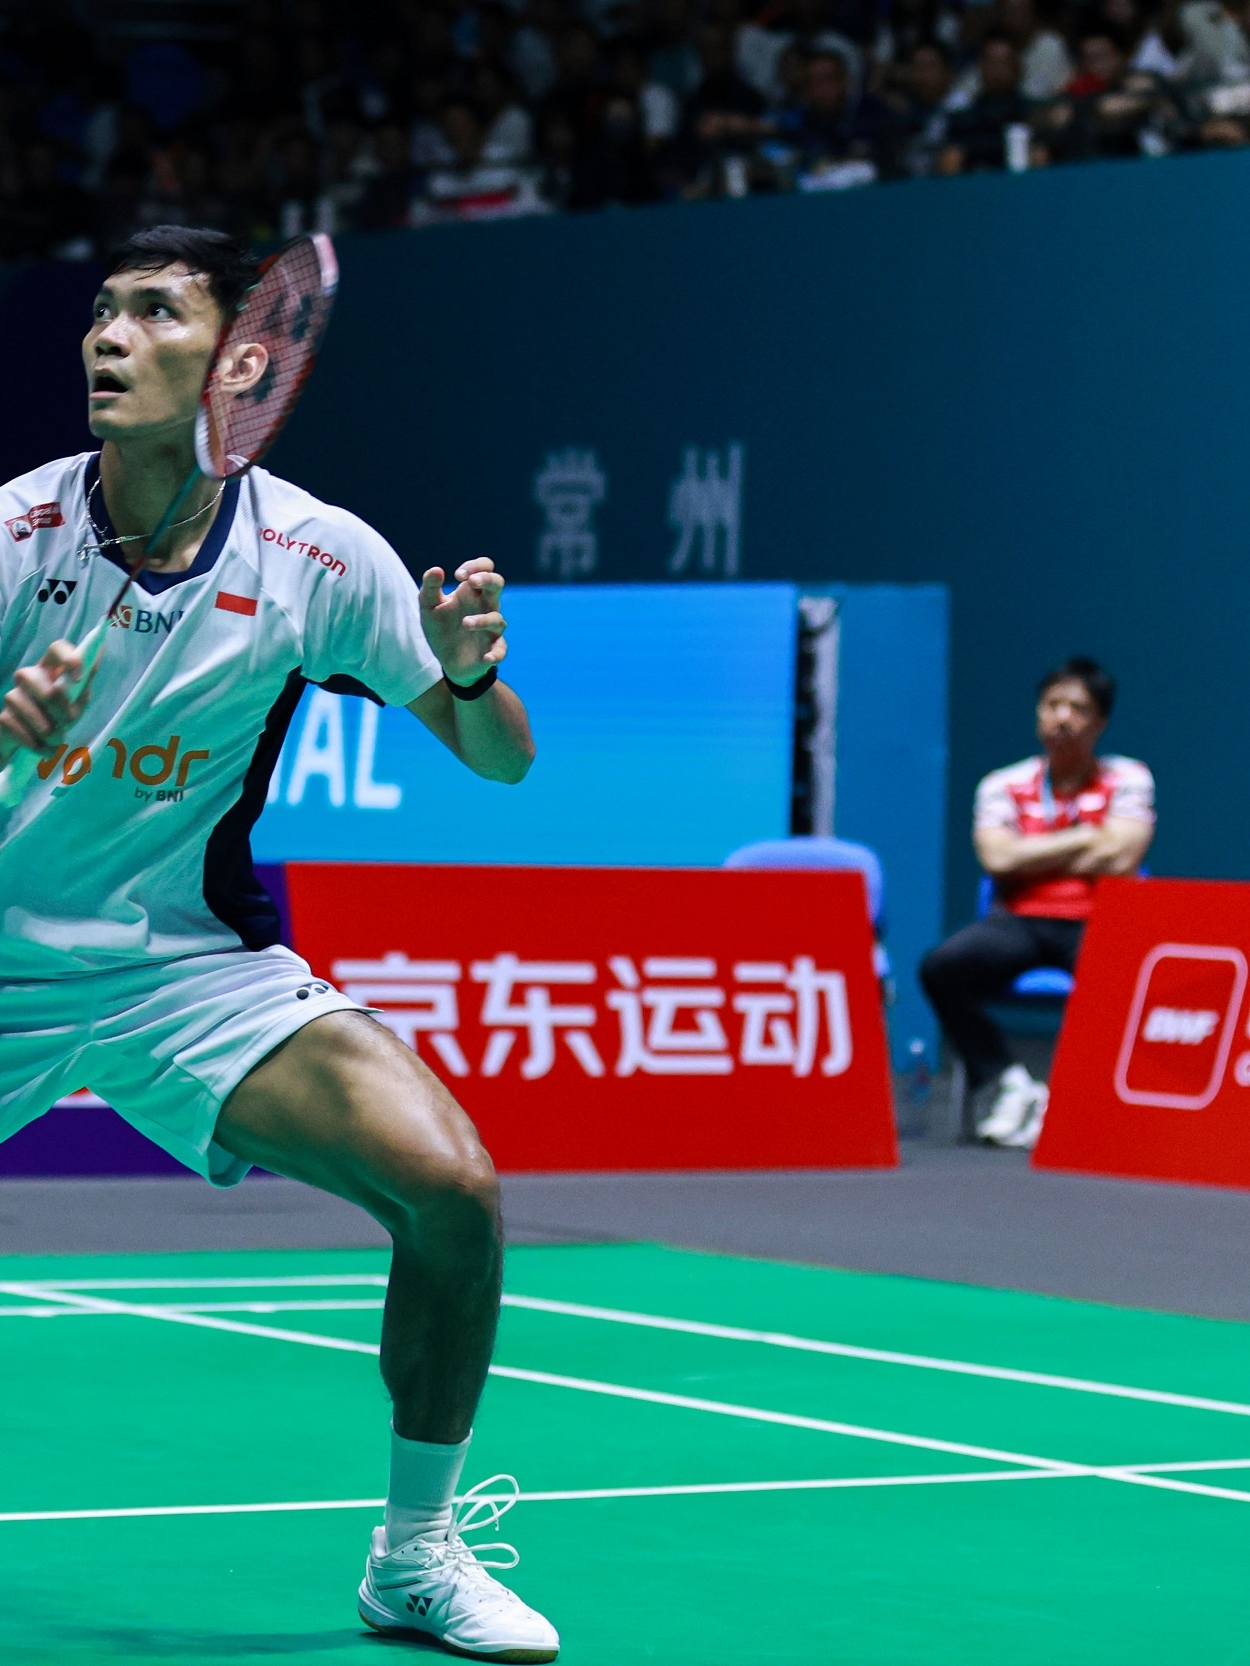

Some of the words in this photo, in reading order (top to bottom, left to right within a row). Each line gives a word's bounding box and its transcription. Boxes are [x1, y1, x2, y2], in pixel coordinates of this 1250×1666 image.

[134, 787, 152, 802] by
[156, 789, 184, 802] BNI
[331, 951, 851, 1080] 京东运动
